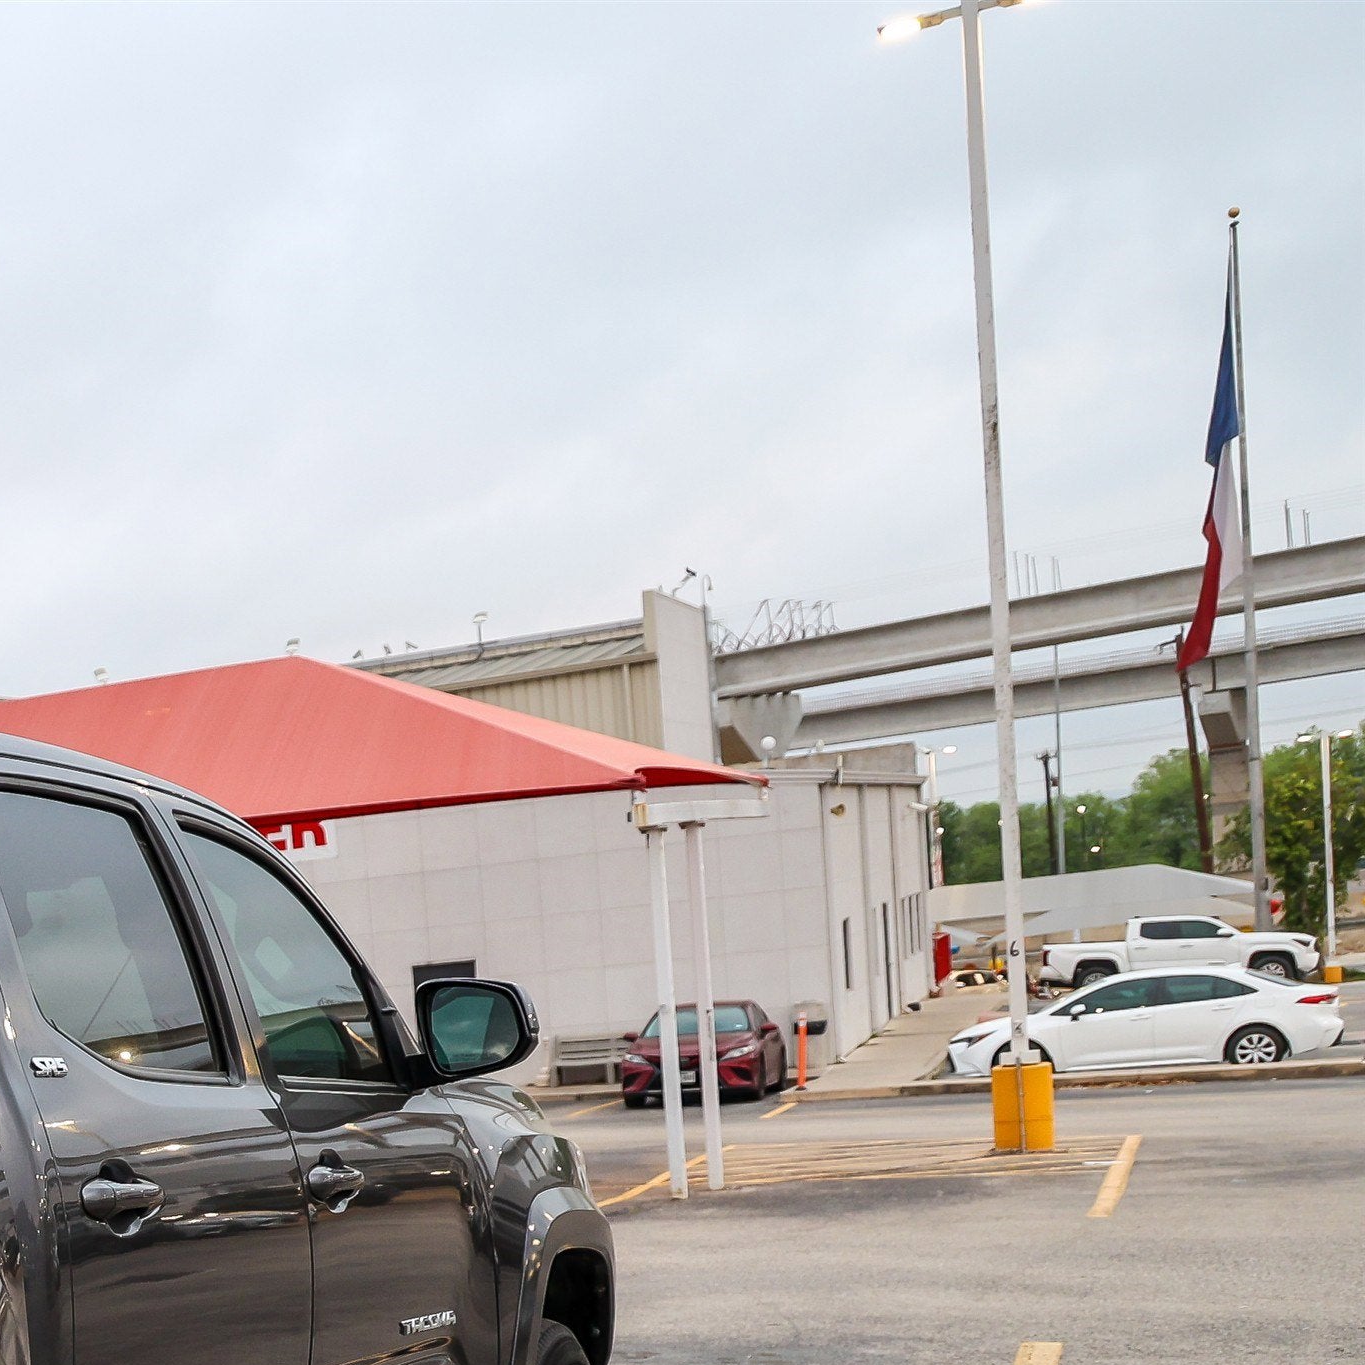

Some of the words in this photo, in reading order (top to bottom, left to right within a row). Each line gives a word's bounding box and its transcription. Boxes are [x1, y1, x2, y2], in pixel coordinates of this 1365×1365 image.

[1010, 940, 1020, 957] 6
[30, 1056, 69, 1078] SR5
[399, 1310, 457, 1336] TACOMA
